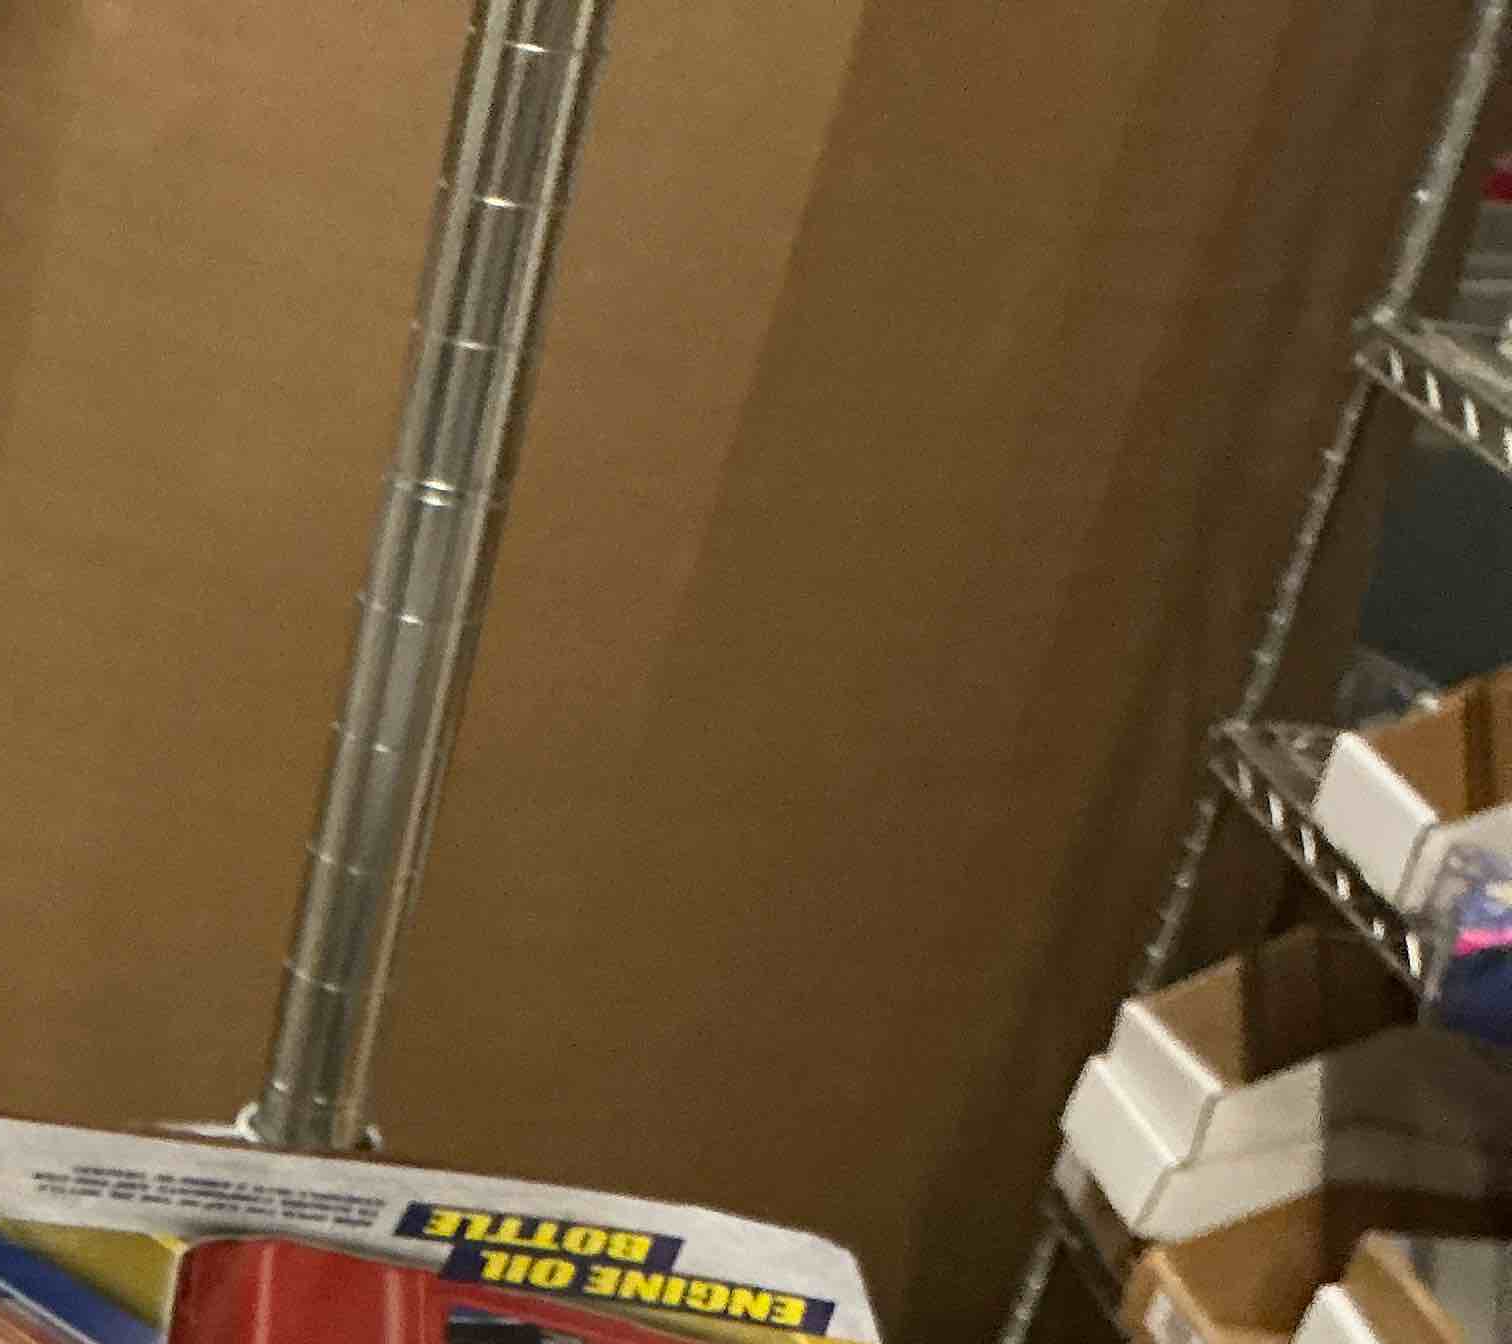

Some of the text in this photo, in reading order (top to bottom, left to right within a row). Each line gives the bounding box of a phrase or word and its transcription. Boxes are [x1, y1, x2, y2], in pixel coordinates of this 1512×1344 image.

[423, 1208, 653, 1264] BOTTLE
[479, 1249, 807, 1328] ENGINE OIL
